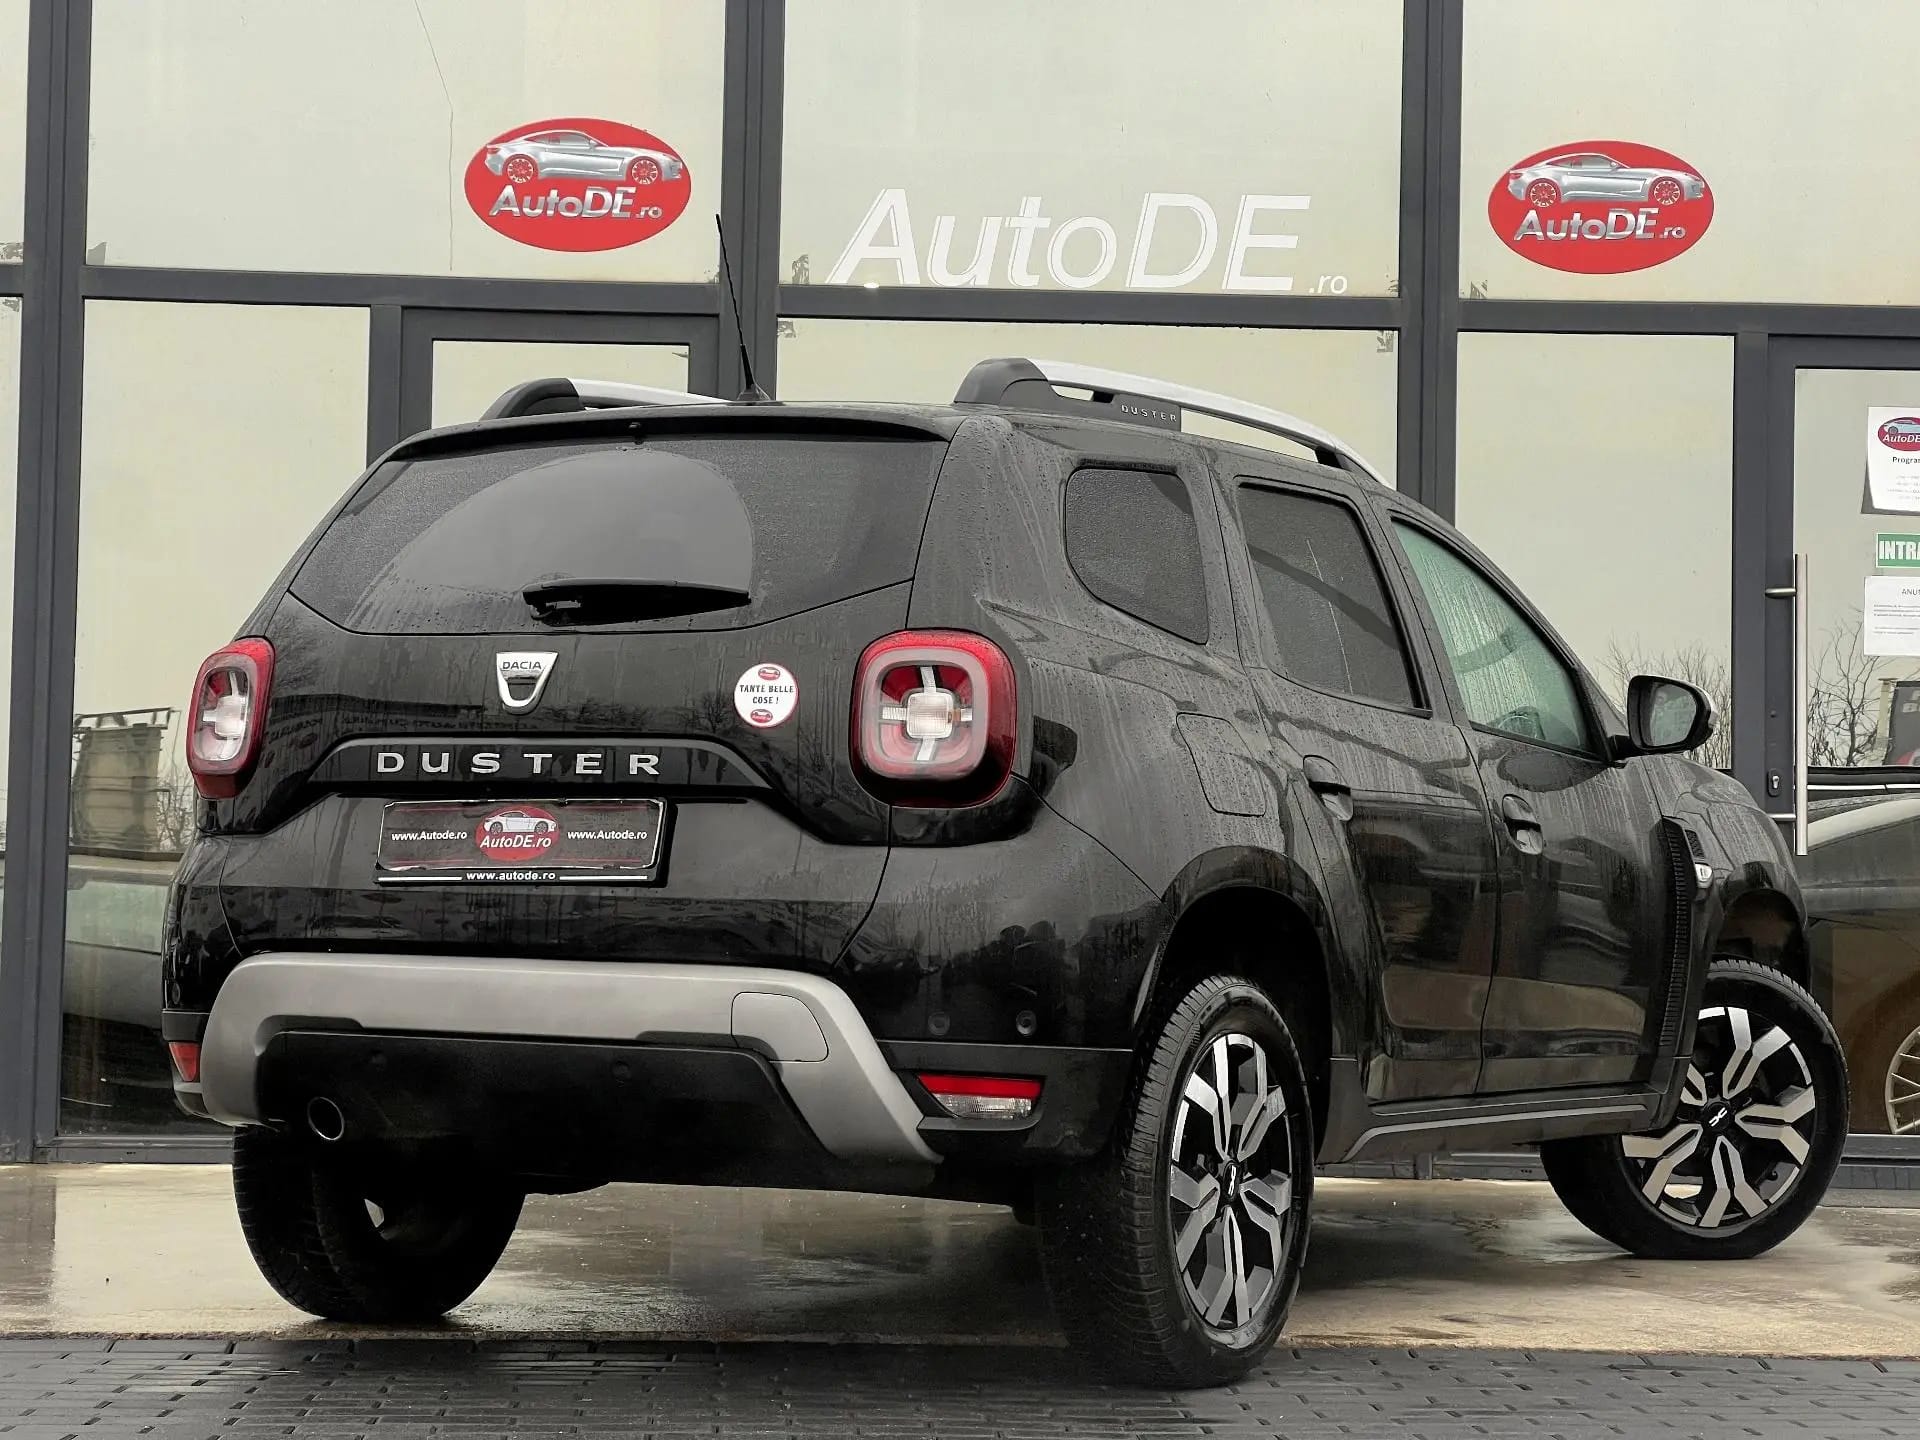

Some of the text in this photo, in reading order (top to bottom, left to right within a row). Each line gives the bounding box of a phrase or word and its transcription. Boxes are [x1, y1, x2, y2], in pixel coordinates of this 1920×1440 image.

[489, 185, 663, 218] AutoDE .ro
[1513, 207, 1686, 241] AutoDE .ro
[824, 188, 1348, 295] AutoDE .ro
[1121, 404, 1177, 422] DUSTER
[502, 661, 542, 671] DACIA
[740, 684, 794, 693] TANTE BELLE
[752, 696, 774, 704] COSE
[376, 752, 660, 775] DUSTER
[391, 830, 467, 841] www.Autode.ro
[567, 829, 647, 840] www.Autode.ro
[480, 834, 551, 849] AutoDE.ro
[466, 871, 556, 881] www.autode.ro
